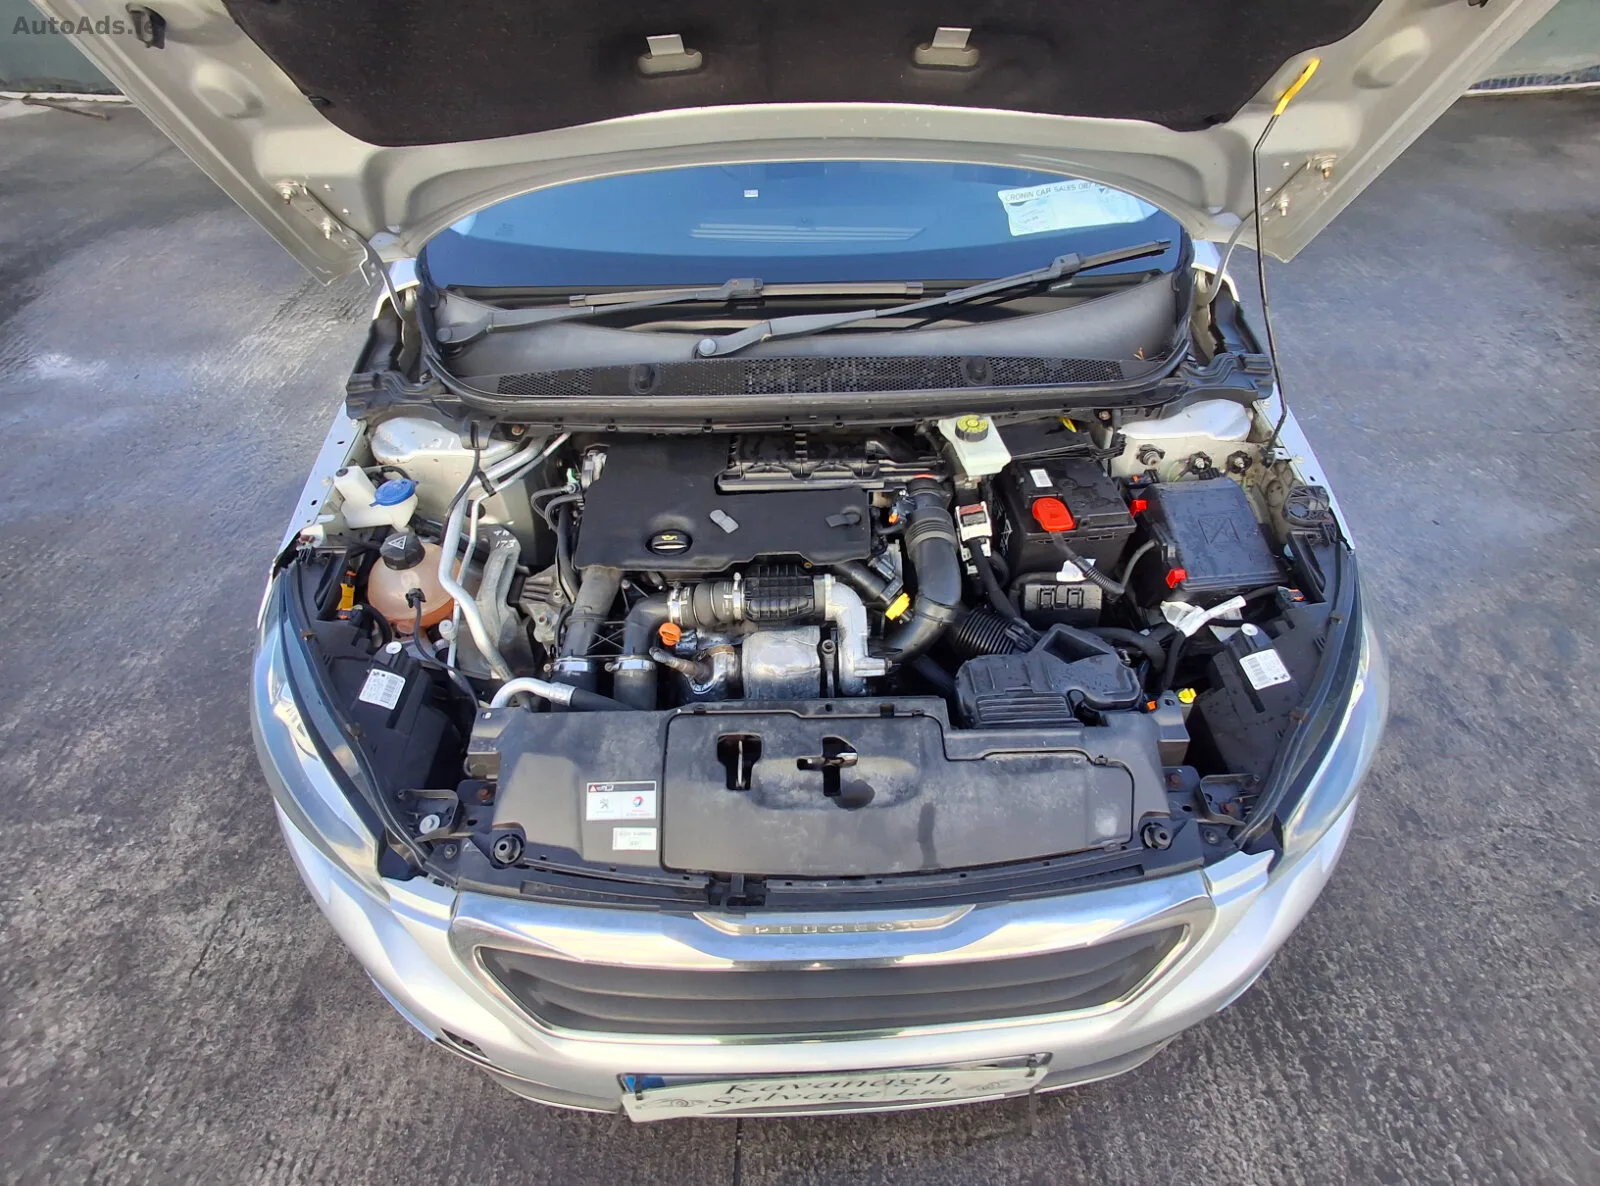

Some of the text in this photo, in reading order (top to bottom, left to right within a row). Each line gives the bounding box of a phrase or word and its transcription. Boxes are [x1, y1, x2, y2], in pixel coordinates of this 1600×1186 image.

[1036, 187, 1051, 197] CAR
[1054, 184, 1077, 193] SALES
[725, 1074, 951, 1095] Kavanagh
